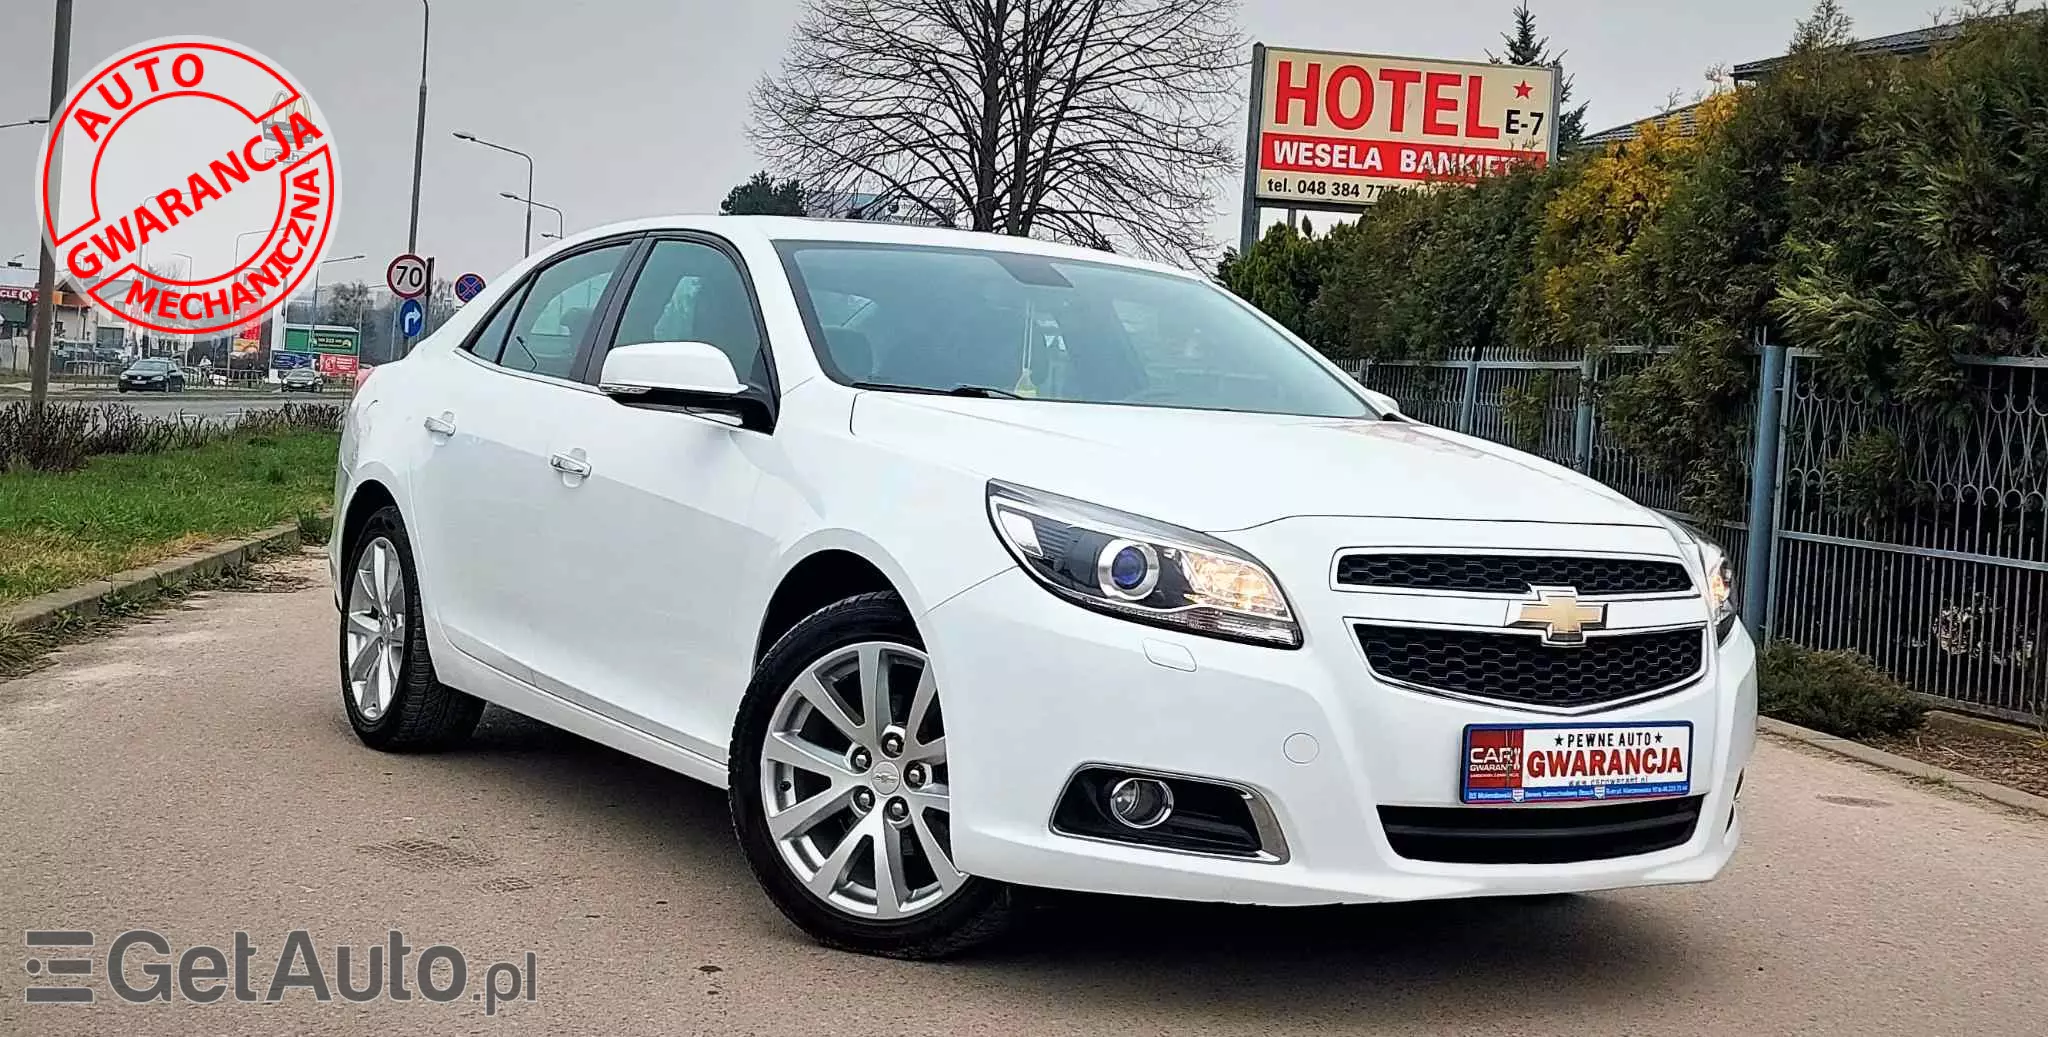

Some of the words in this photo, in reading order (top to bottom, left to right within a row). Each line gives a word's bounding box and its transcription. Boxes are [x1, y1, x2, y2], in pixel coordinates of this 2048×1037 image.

[1274, 62, 1500, 139] HOTEL
[1505, 109, 1544, 136] E-7
[1273, 140, 1383, 171] WESELA
[1267, 178, 1292, 193] tel.
[1297, 179, 1326, 196] 048
[1331, 182, 1360, 198] 384
[1366, 184, 1384, 199] 77
[396, 265, 423, 288] 70
[1567, 733, 1614, 748] PEWNE
[1618, 732, 1651, 746] AUTO
[1470, 747, 1513, 763] CAR
[1526, 746, 1683, 778] GWARANCJA
